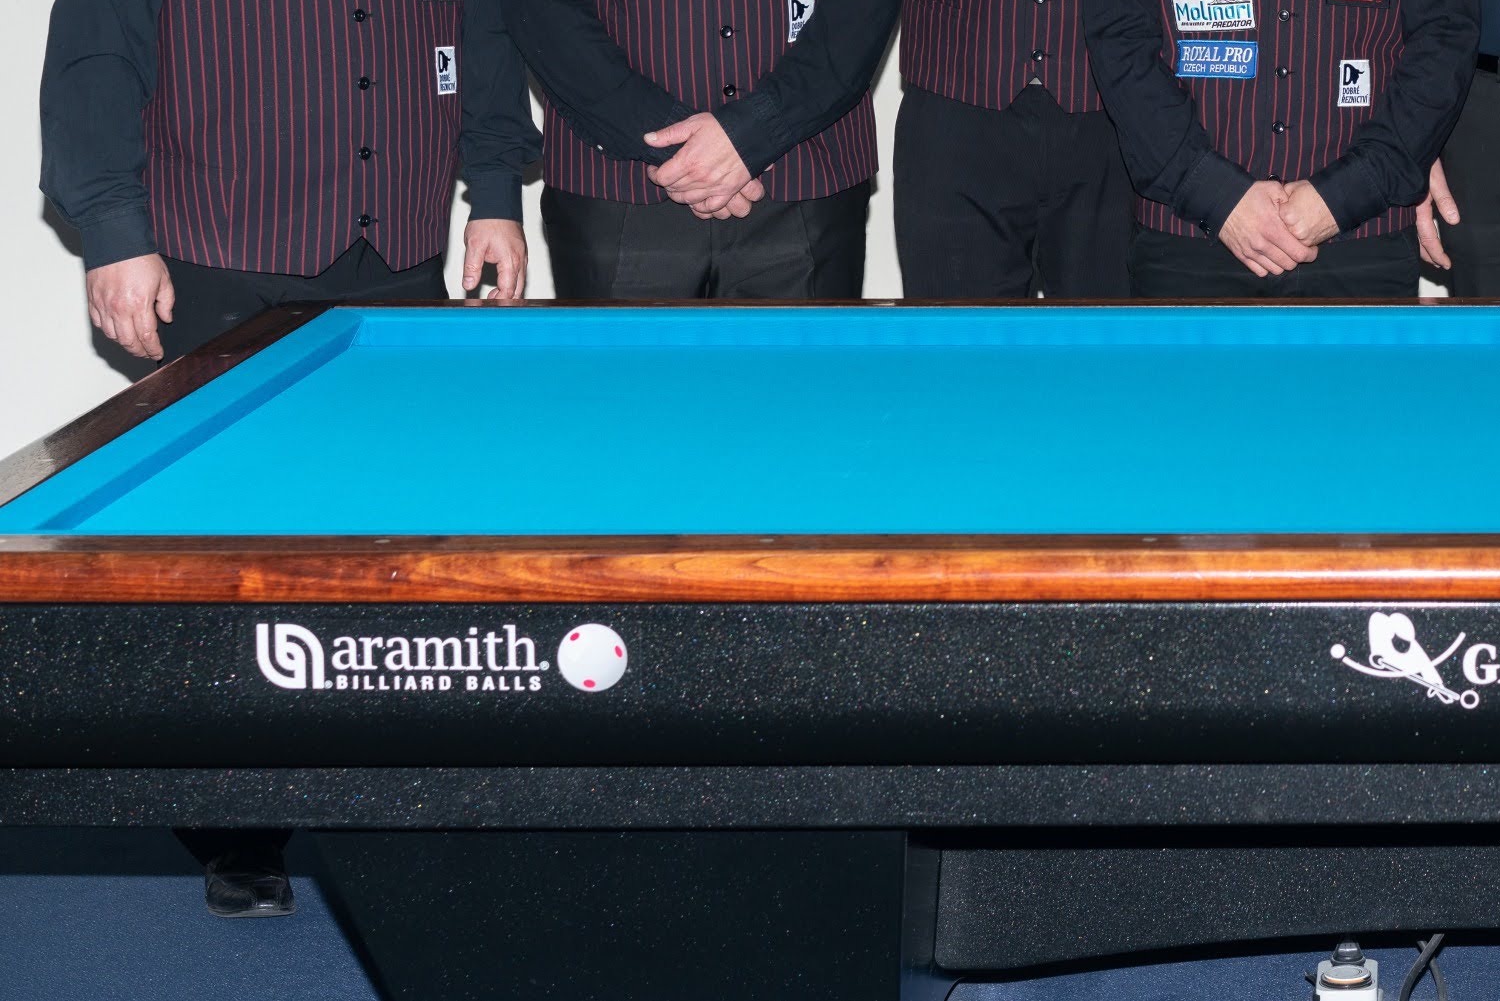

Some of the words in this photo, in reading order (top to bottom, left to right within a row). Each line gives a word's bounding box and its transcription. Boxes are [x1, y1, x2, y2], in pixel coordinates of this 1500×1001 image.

[1211, 20, 1253, 29] PREDATOR
[1181, 46, 1221, 62] ROYAL
[1222, 46, 1253, 63] PRO
[1183, 63, 1206, 73] CZECH
[1209, 63, 1248, 74] REPUBLIC
[1342, 85, 1360, 95] DOBRÉ
[1341, 94, 1369, 104] ŘEZNICTVÍ
[331, 624, 540, 671] aramith
[336, 675, 452, 691] BILLIARD
[466, 675, 542, 691] BALLS
